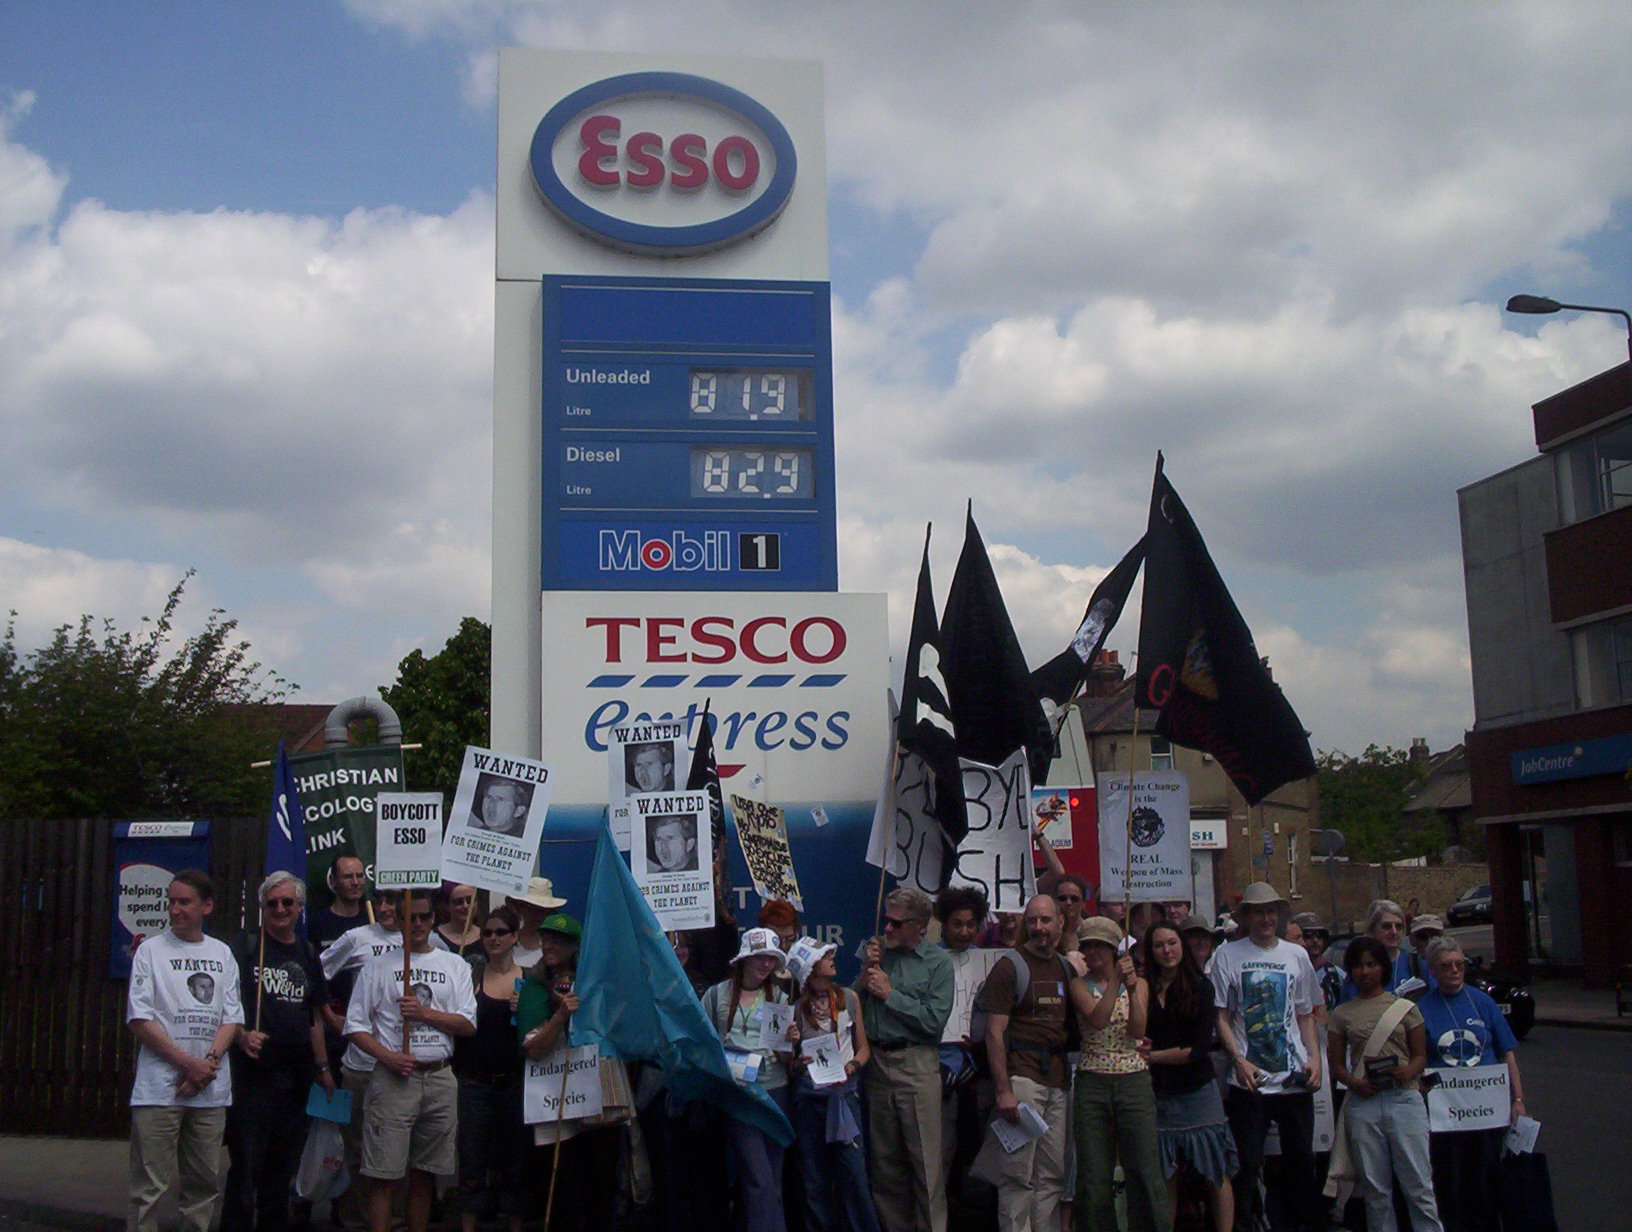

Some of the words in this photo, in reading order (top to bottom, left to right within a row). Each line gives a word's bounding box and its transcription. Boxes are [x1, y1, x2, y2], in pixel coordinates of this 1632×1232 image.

[566, 368, 650, 385] Unleaded
[566, 406, 592, 416] Litre
[566, 447, 621, 463] Diesel
[566, 485, 592, 495] Litre
[599, 530, 731, 572] Mobil
[585, 616, 848, 664] TESCO
[584, 699, 851, 752] epress
[614, 724, 681, 743] WANTED
[473, 752, 549, 784] WANTED
[1520, 756, 1574, 776] JobCentre
[1147, 782, 1180, 792] Change
[636, 796, 705, 815] WANTED
[1144, 794, 1157, 803] the
[301, 796, 378, 824] COLOG
[381, 803, 439, 820] BOYCOTT
[305, 827, 347, 855] INK
[393, 827, 427, 845] ESSO
[467, 839, 497, 853] CRIMES
[497, 846, 532, 862] AGAINST
[1130, 854, 1163, 864] REAL
[465, 852, 481, 863] THE
[481, 855, 513, 871] PLANET
[380, 870, 408, 884] GREEN
[408, 870, 438, 883] PARTY
[1110, 867, 1147, 877] Wepon
[1149, 867, 1158, 876] of
[1160, 867, 1183, 876] Mass
[119, 884, 163, 898] Helping
[651, 884, 680, 896] CRIMES
[681, 881, 710, 893] AGAINST
[127, 901, 161, 914] spend
[653, 898, 668, 908] THE
[669, 896, 698, 908] PLANET
[136, 918, 168, 930] every
[169, 958, 223, 973] WANTED
[530, 1055, 597, 1077] Endangered
[543, 1091, 586, 1110] Spcies
[1448, 1105, 1495, 1121] Species
